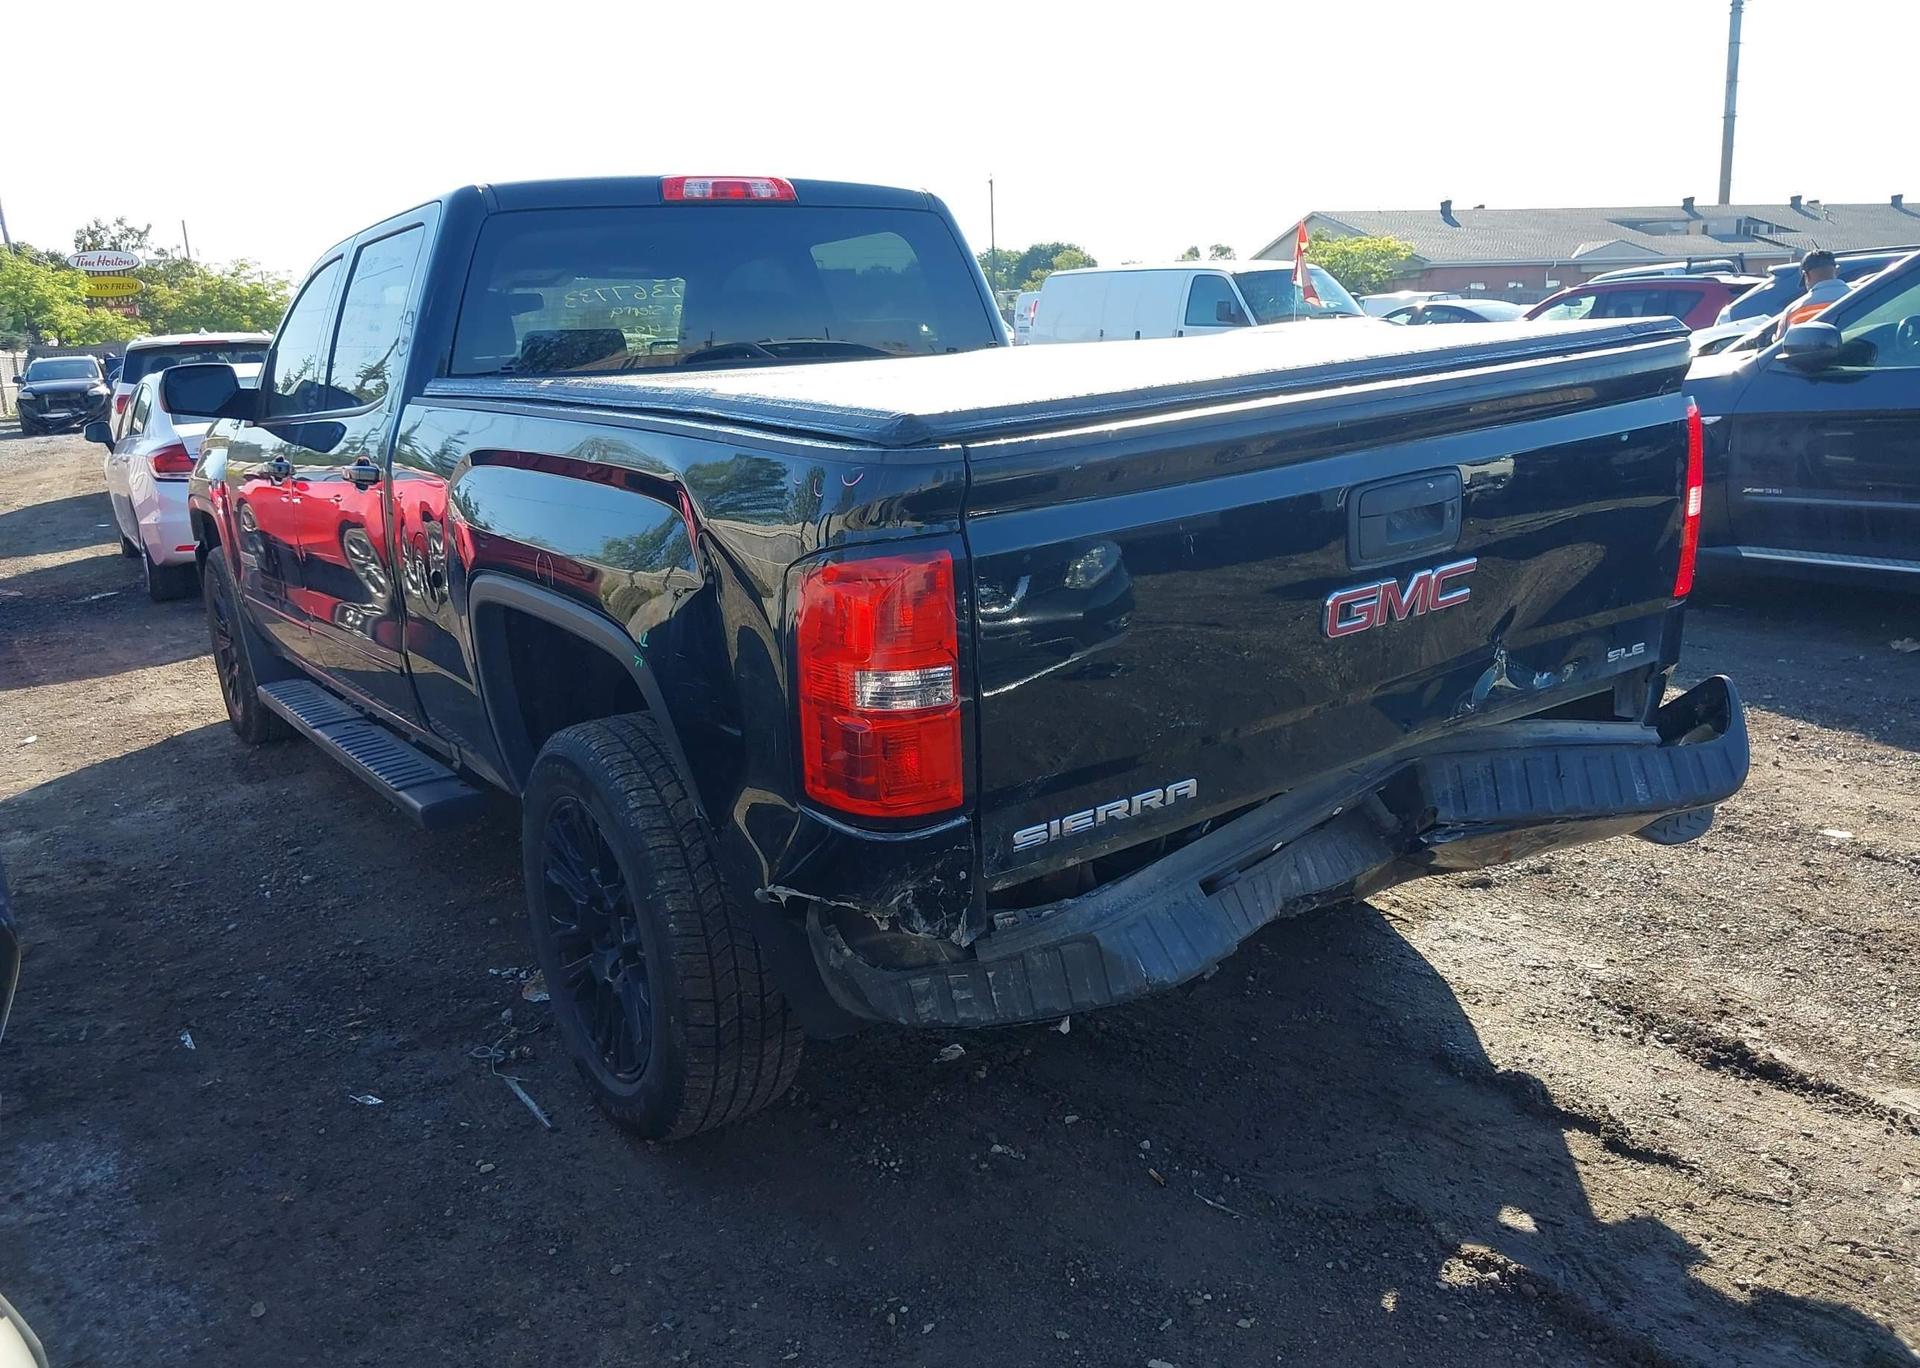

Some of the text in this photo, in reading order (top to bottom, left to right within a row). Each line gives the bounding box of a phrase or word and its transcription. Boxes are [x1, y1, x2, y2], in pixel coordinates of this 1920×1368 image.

[74, 254, 135, 267] Tim Hortons
[111, 282, 138, 290] FRESH
[1325, 556, 1478, 639] GMC
[1607, 641, 1646, 663] SLE
[1012, 778, 1198, 853] SIERRA
